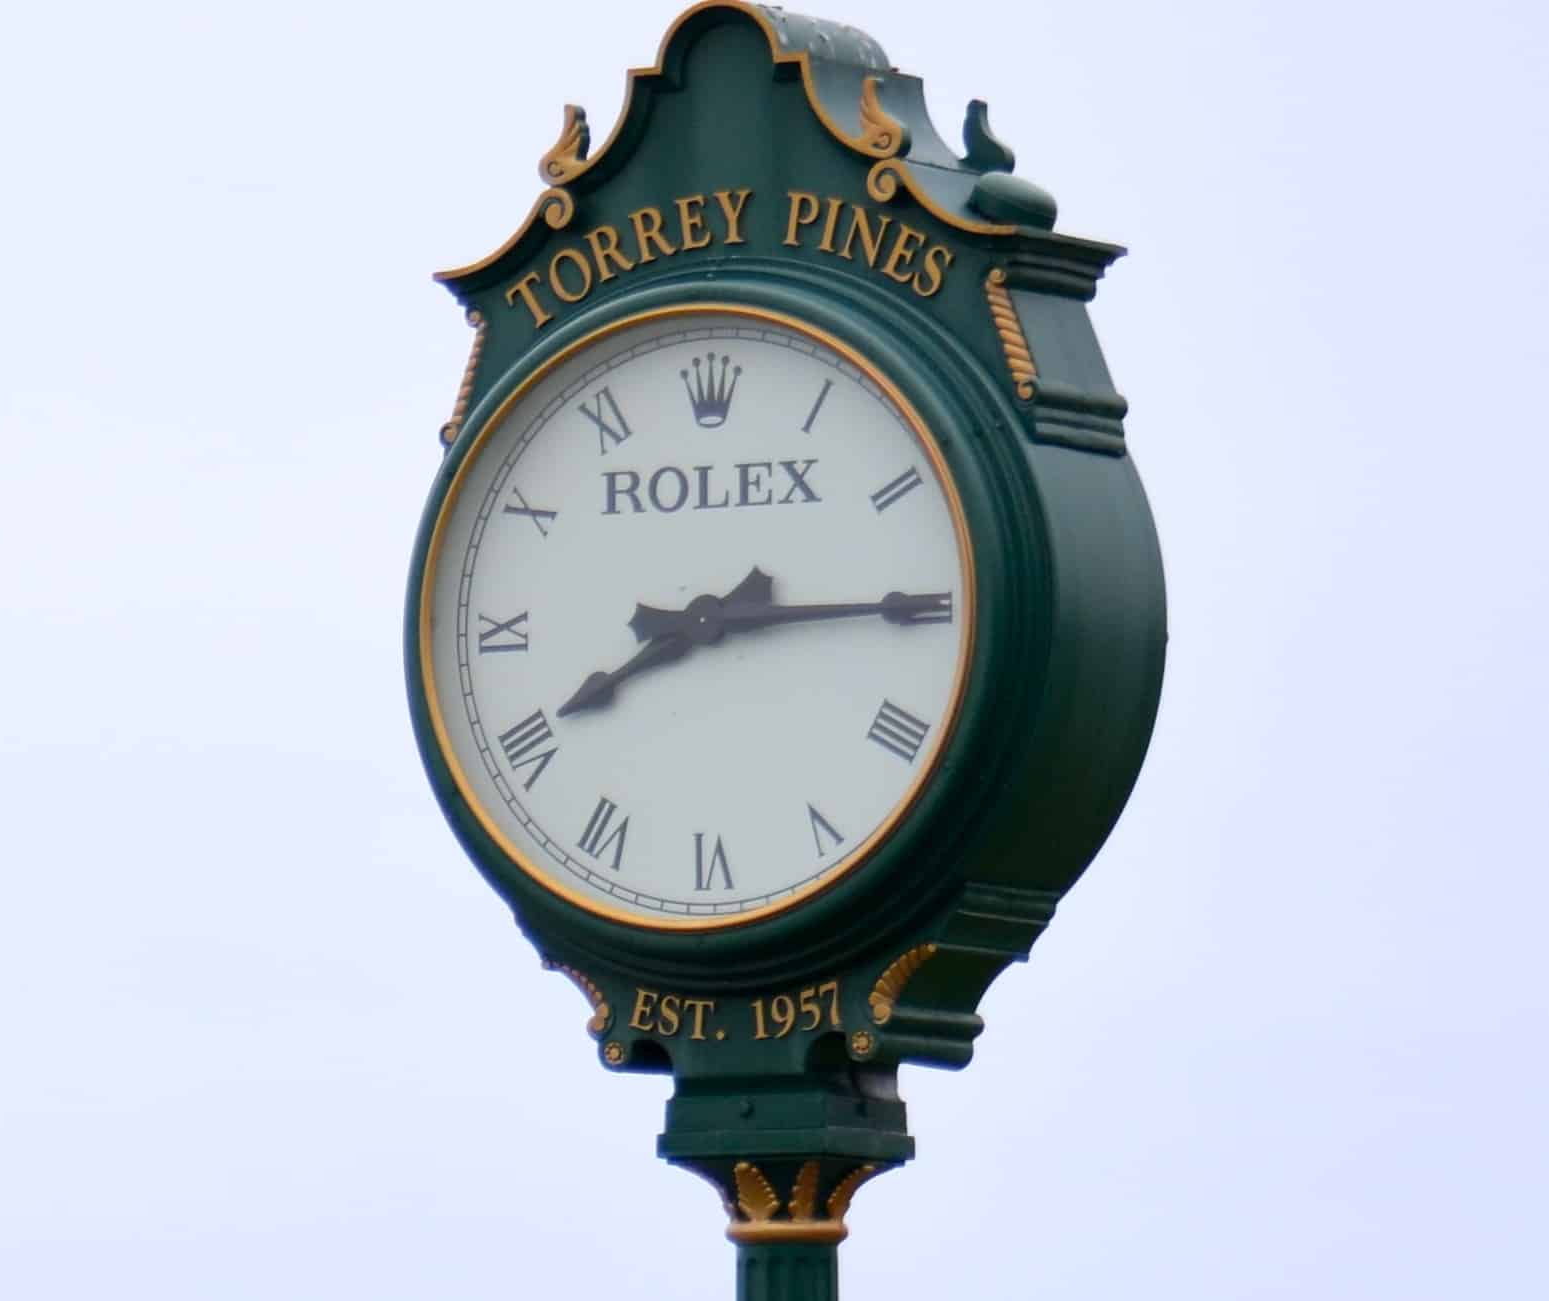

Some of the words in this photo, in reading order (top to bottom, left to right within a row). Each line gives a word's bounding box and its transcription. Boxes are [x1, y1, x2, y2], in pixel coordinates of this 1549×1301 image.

[506, 188, 754, 331] TORREY
[783, 190, 955, 300] PINES
[577, 385, 633, 455] XI
[600, 458, 823, 515] ROLEX
[628, 987, 727, 1041] EST.
[751, 981, 843, 1040] 1957
